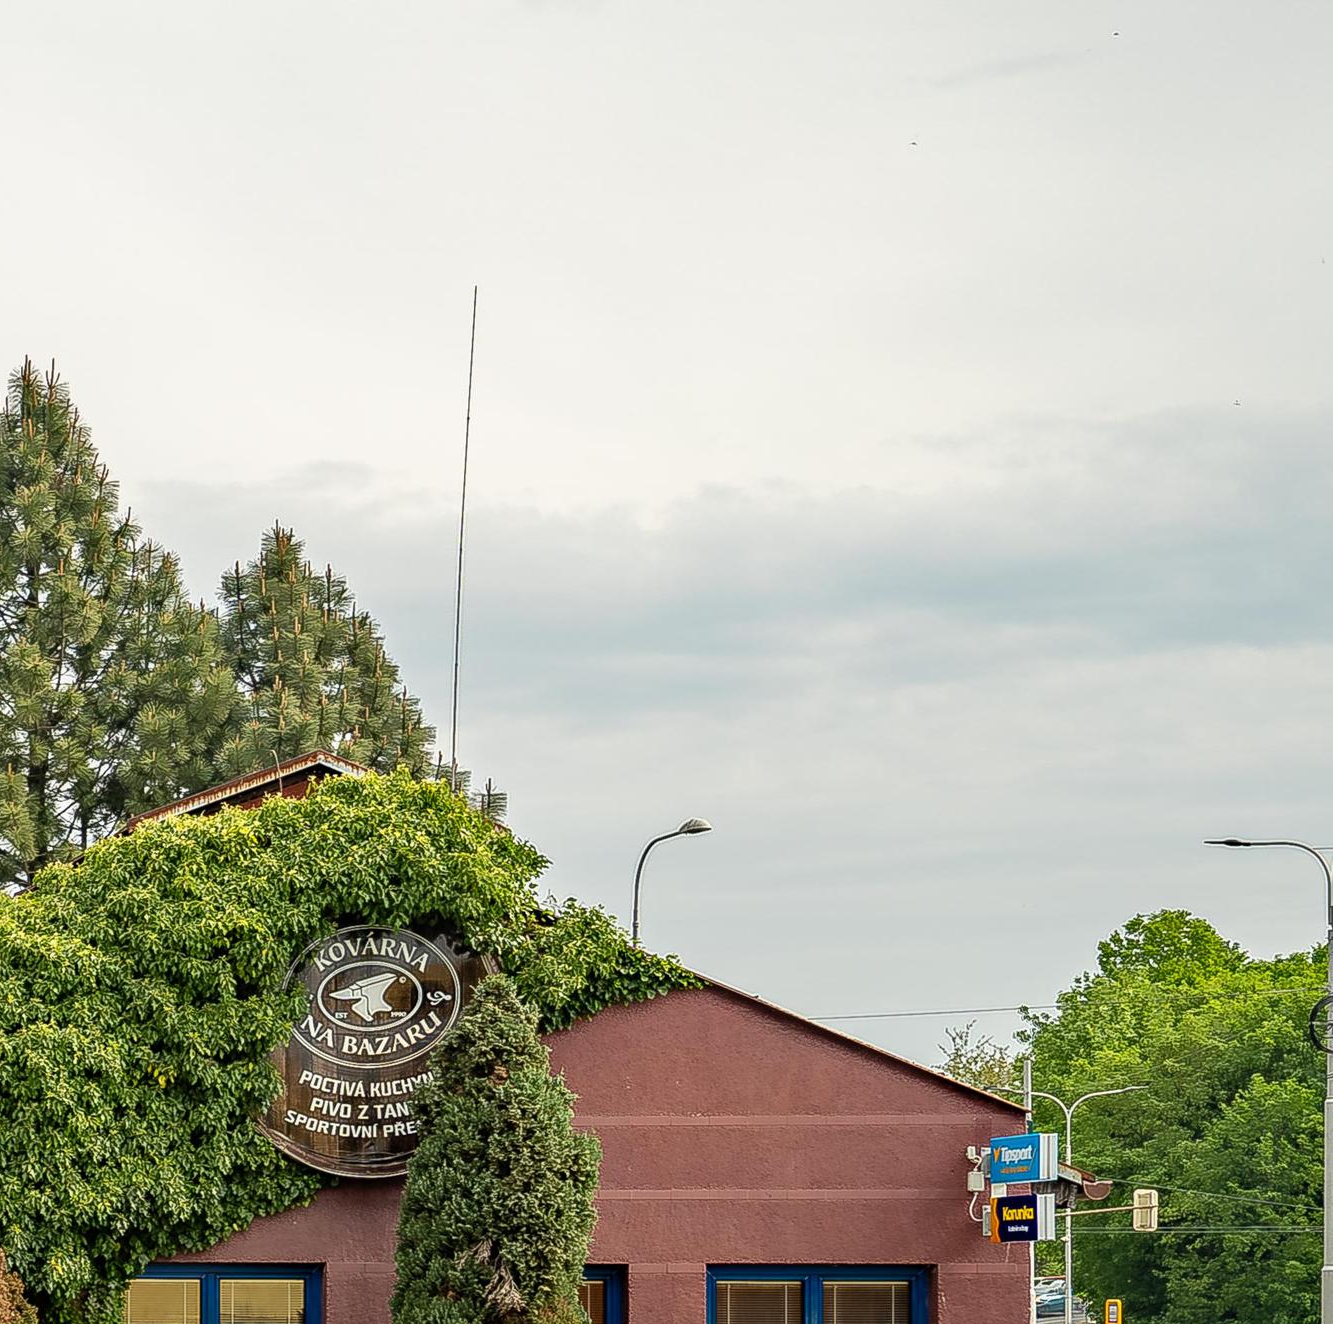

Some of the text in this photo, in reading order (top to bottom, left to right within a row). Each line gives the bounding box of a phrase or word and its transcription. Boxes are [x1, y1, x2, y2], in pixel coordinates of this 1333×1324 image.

[313, 931, 430, 974] KOVÁRNA
[334, 1011, 349, 1019] EST
[300, 1010, 443, 1056] NA BAZARU
[298, 1069, 366, 1098] POCTIVÁ
[309, 1097, 414, 1120] PIVO Z TAN
[284, 1109, 379, 1138] SPORTOVNÍ
[1000, 1144, 1033, 1165] Tipsport
[1002, 1205, 1035, 1221] Korunka
